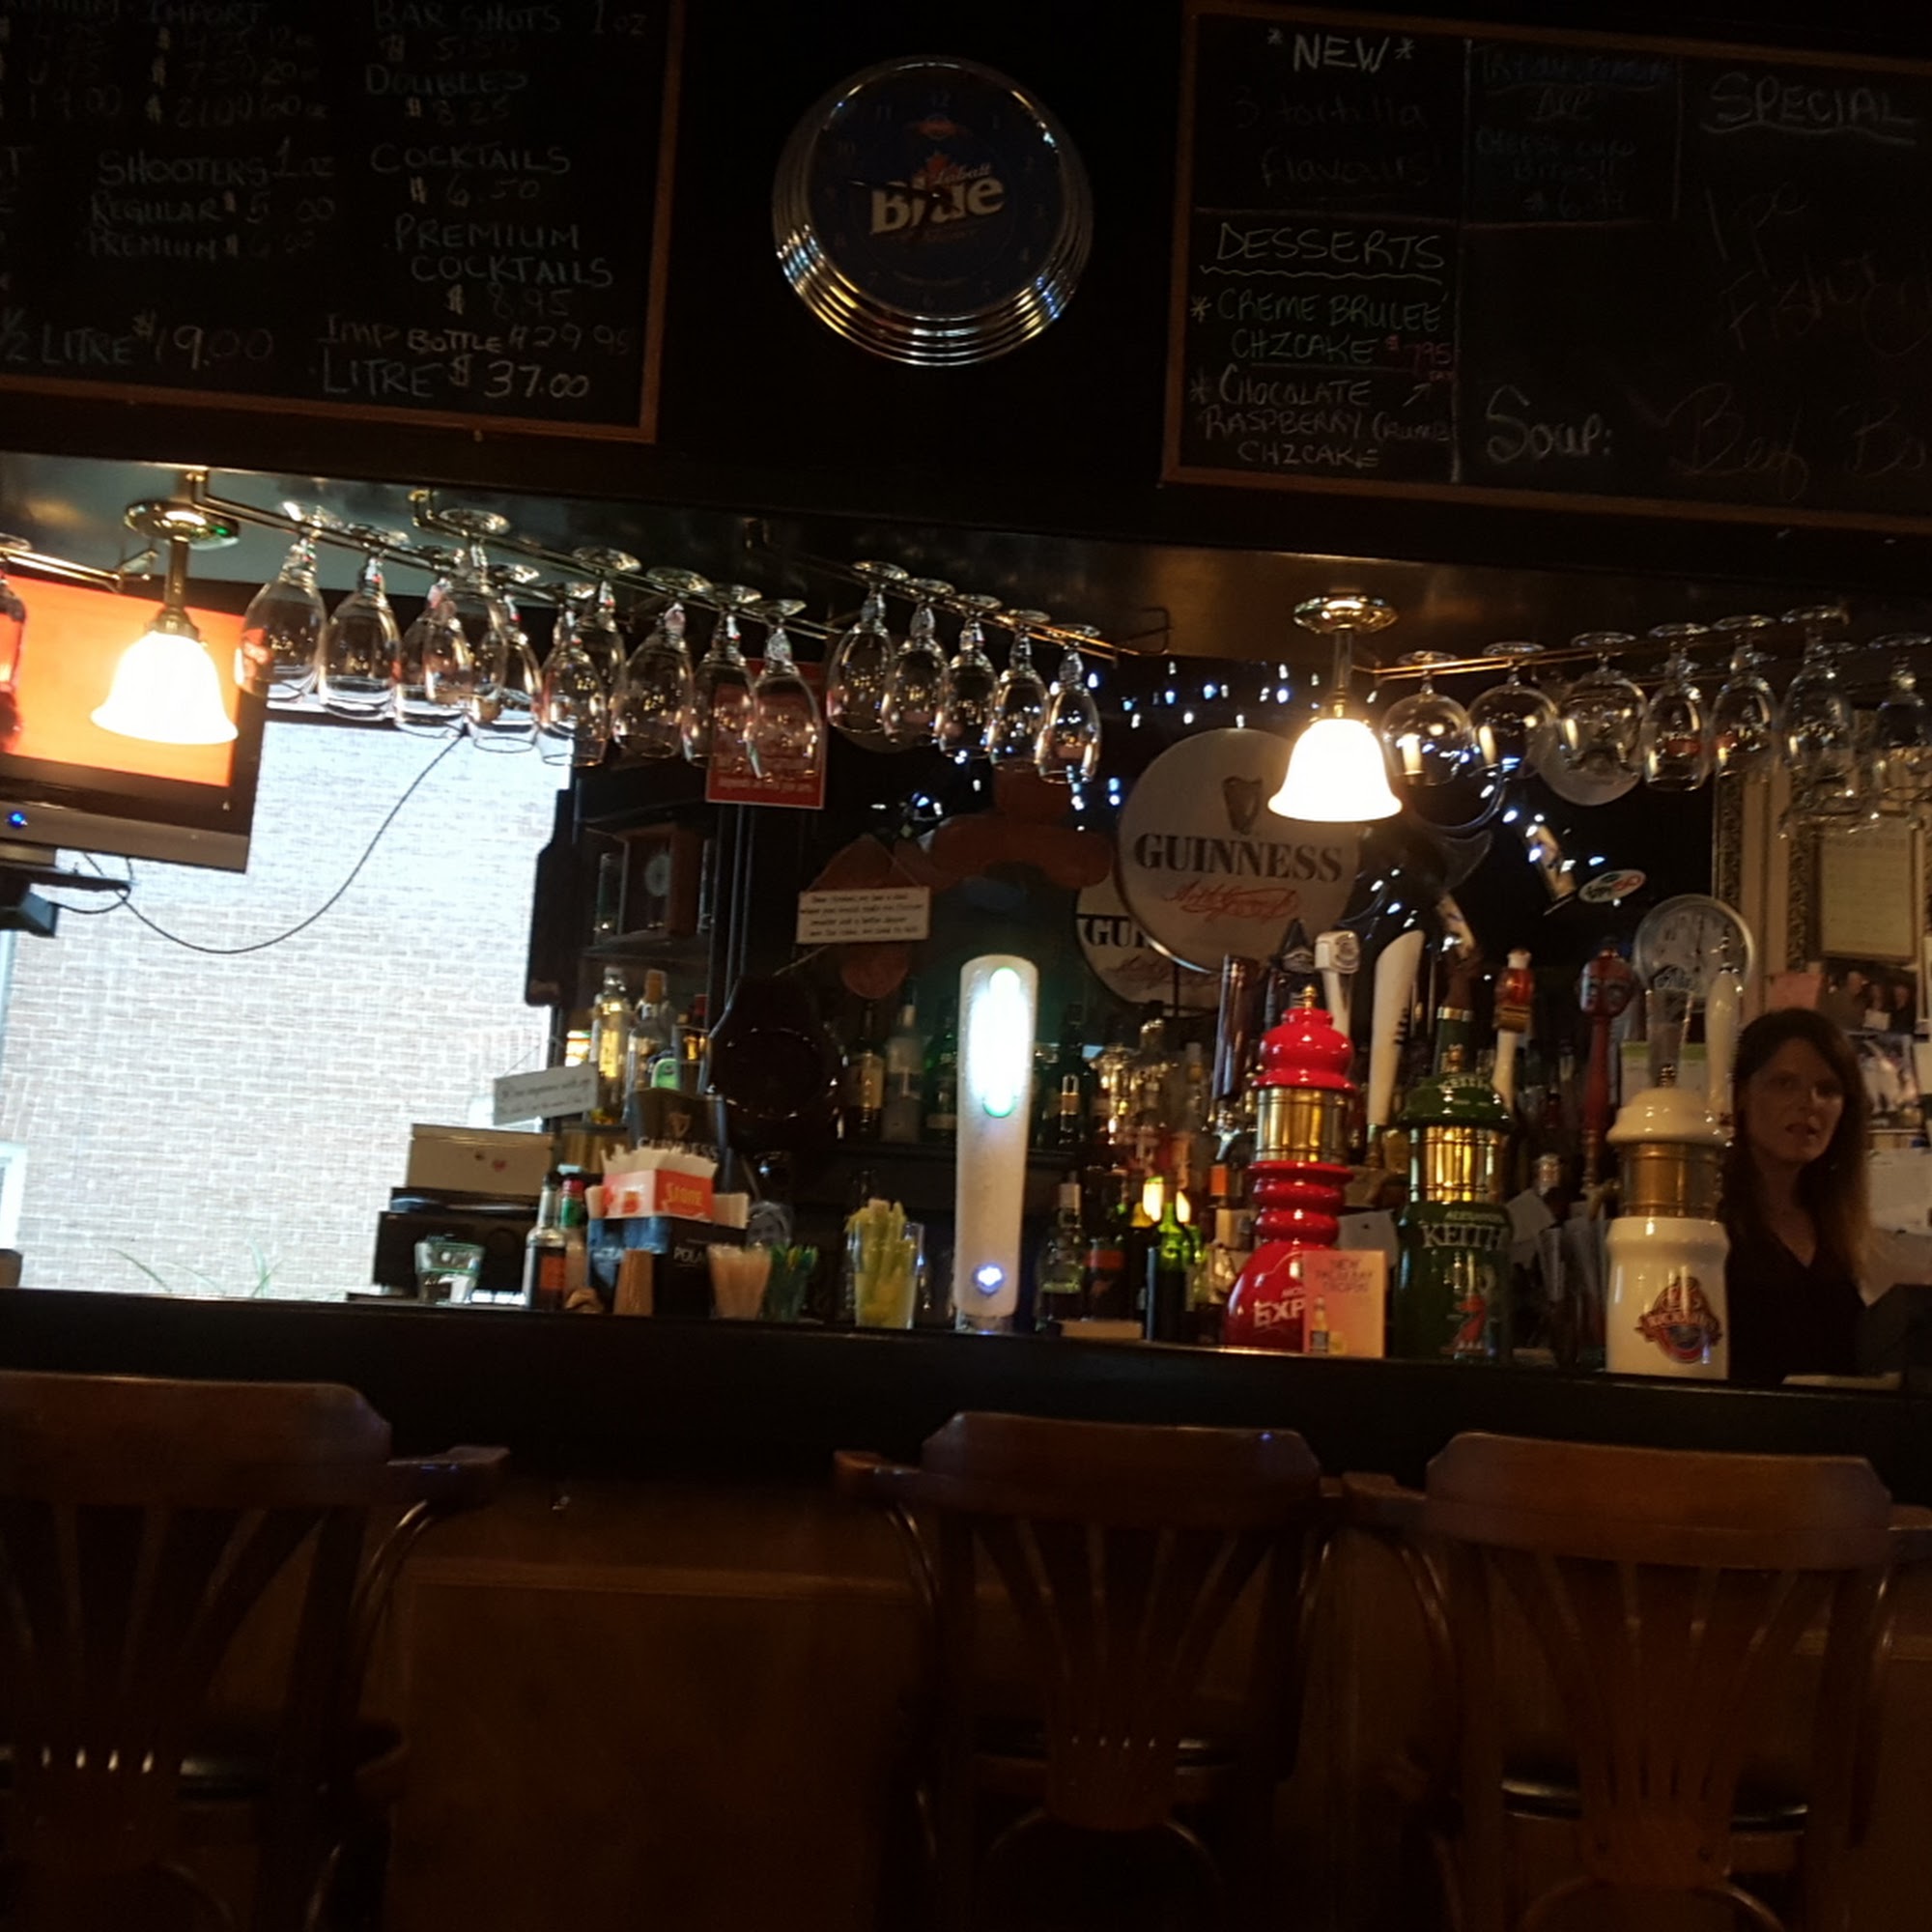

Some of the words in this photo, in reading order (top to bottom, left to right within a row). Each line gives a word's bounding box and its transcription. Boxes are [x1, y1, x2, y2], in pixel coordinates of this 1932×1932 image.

[98, 149, 270, 187] SHOOTERS
[370, 141, 571, 175] COCKTAILS
[91, 188, 223, 227] REGULAR
[394, 212, 580, 252] PREMIUM
[1216, 221, 1445, 270] DESSERTS
[410, 255, 614, 289] COCKTAILS
[1231, 328, 1379, 363] CHZCAKE
[322, 345, 445, 398] LITRE
[1218, 363, 1373, 407] CHOCOLATE
[1205, 404, 1362, 440] RASPBERRY
[1237, 440, 1380, 469] CHZCAKE
[1133, 833, 1343, 883] GUINNESS
